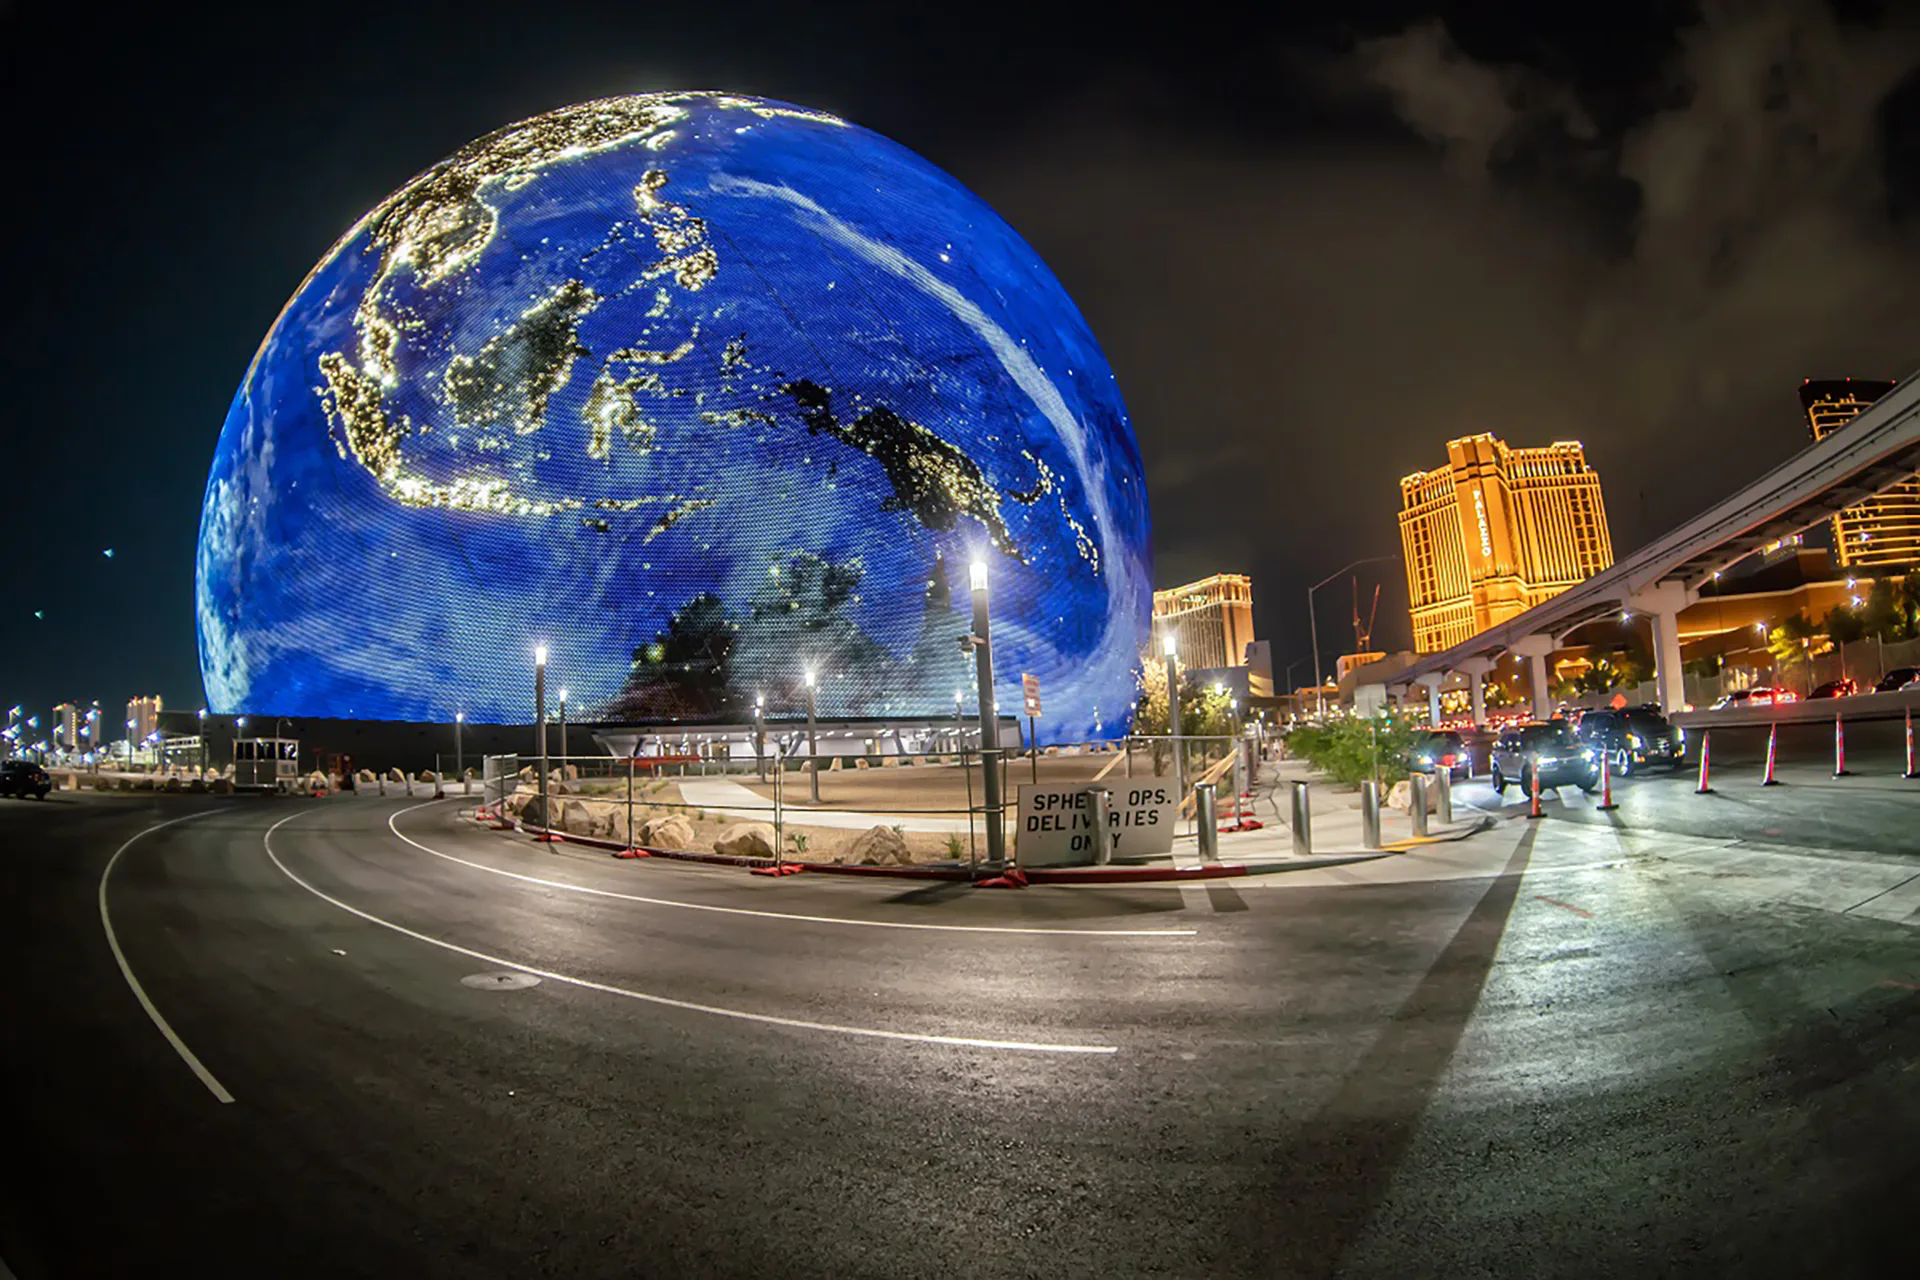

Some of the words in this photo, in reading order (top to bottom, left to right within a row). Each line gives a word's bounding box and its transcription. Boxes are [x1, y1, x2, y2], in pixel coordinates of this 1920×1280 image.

[1472, 489, 1492, 557] PALAZZO
[1033, 791, 1114, 811] SPHE
[1128, 788, 1172, 806] OPS.
[1027, 809, 1159, 832] DELIVRIES
[1070, 832, 1122, 851] ONY
